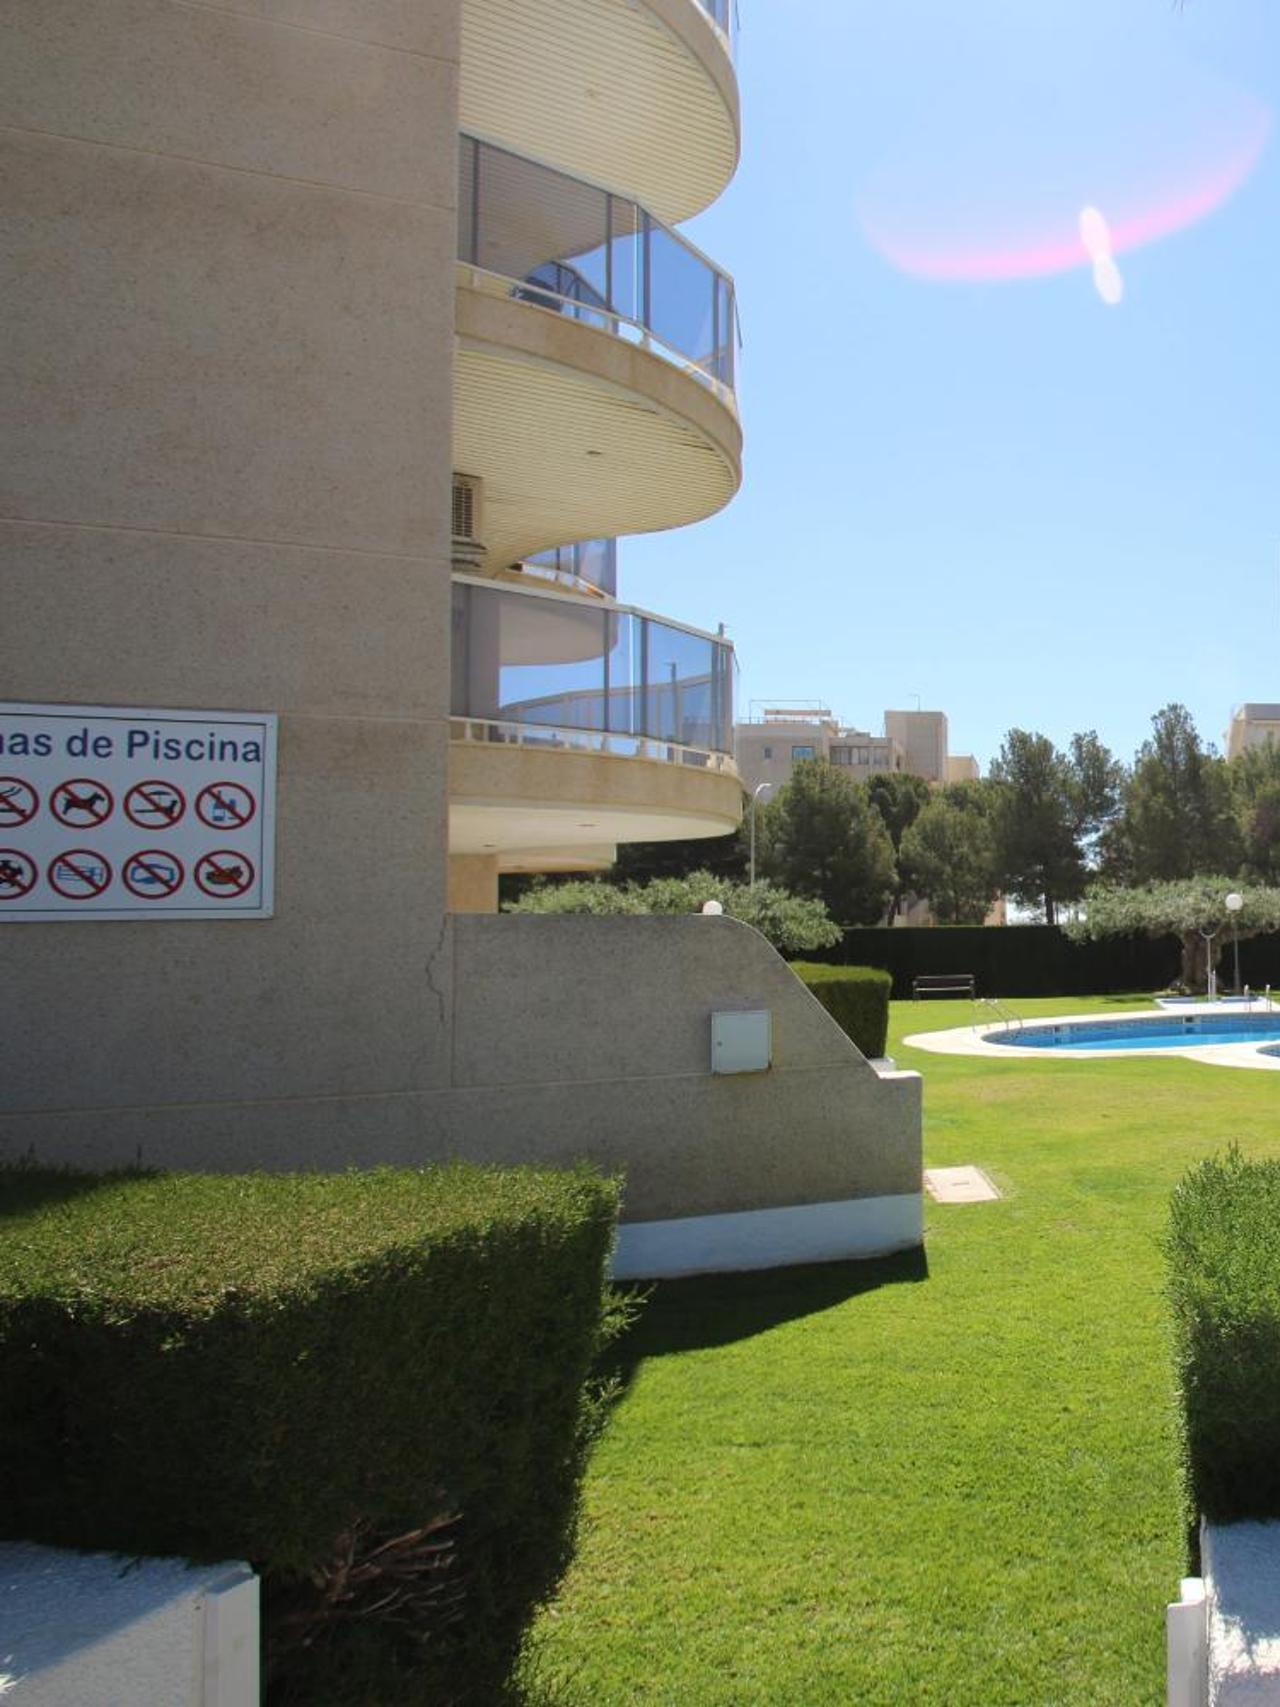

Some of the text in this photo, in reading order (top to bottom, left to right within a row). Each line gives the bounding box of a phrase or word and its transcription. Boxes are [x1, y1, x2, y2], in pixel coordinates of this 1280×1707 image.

[0, 728, 261, 763] as de Piscina
